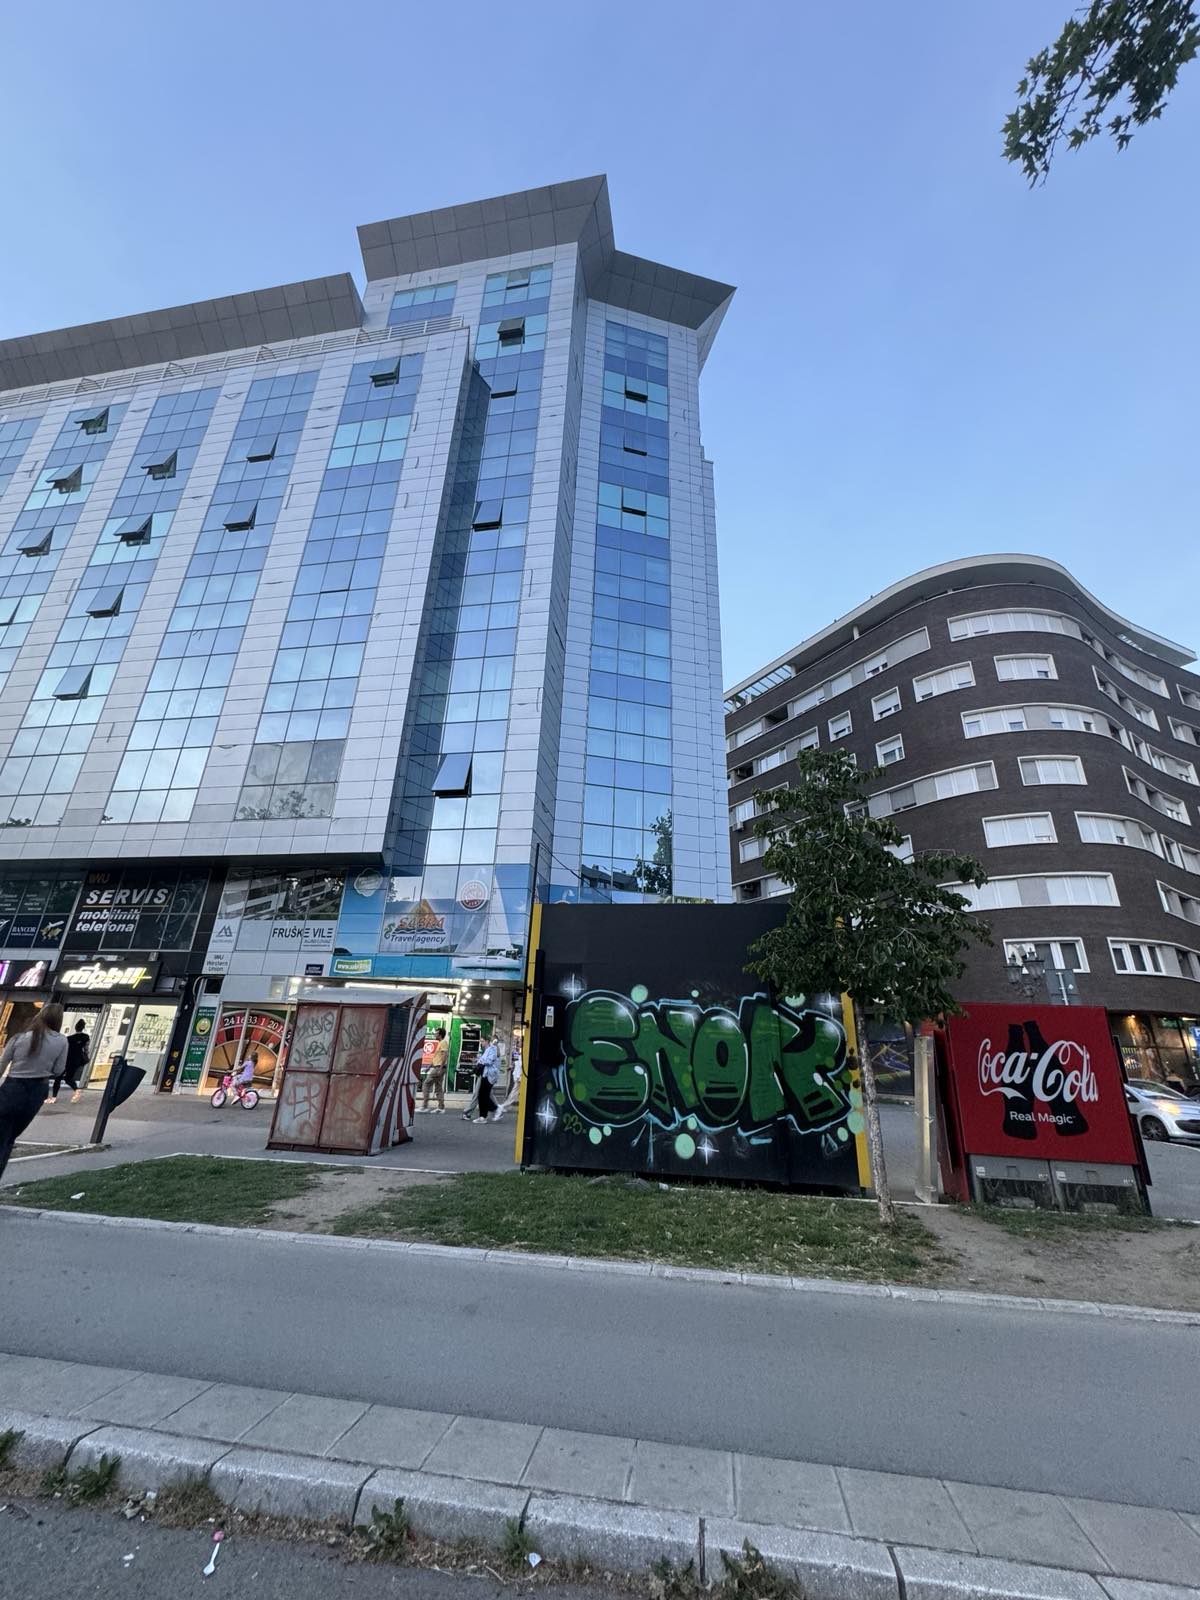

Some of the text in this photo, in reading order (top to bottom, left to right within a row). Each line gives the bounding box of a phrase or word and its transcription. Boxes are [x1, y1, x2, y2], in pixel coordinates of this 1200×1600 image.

[86, 888, 169, 905] SERVIS
[78, 909, 140, 920] mobilnih
[75, 921, 135, 932] telefona
[398, 917, 445, 929] SABRA
[272, 925, 334, 938] FRUŠKE VILE
[390, 934, 447, 944] Travel agency
[224, 1017, 235, 1027] 24
[260, 1017, 265, 1026] 1
[267, 1020, 279, 1030] 20
[978, 1038, 1099, 1103] Coca-Cola
[1009, 1111, 1074, 1125] Real Magic
